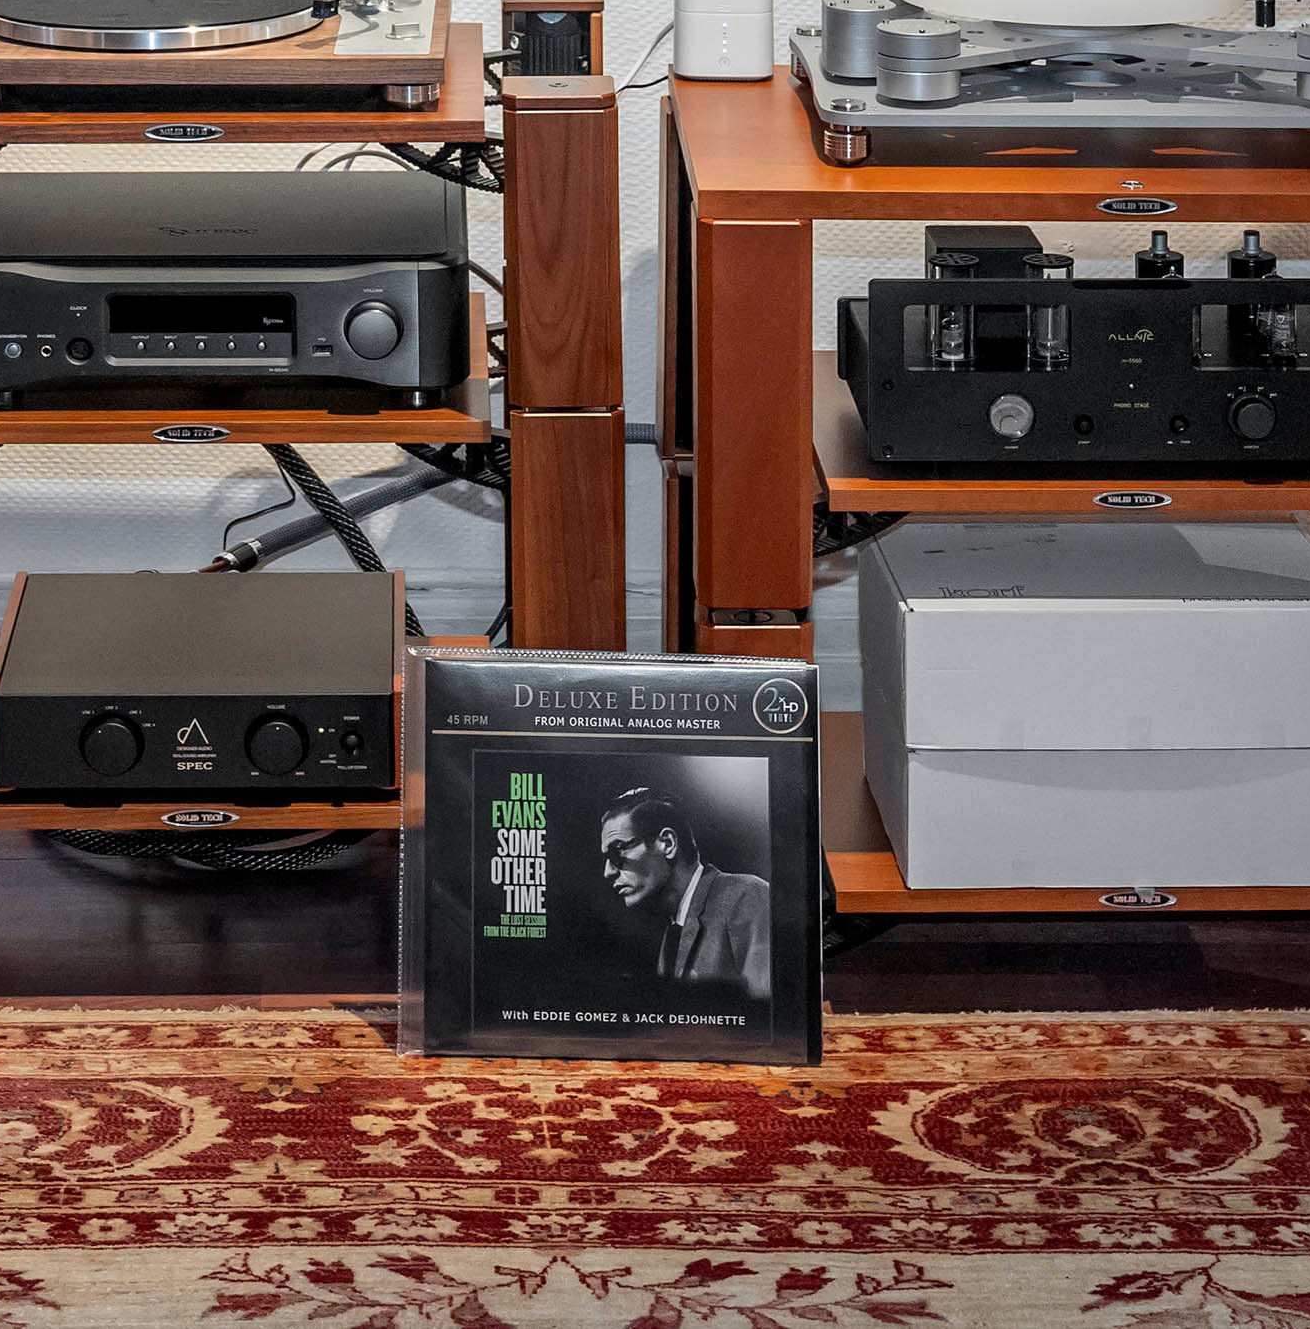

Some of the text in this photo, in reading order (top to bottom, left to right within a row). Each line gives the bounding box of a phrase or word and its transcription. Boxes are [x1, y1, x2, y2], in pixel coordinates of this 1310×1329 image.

[1112, 202, 1161, 210] SOLID TECH
[1108, 329, 1155, 343] ALLNIC
[1107, 495, 1156, 503] SOLID TECH
[446, 715, 489, 726] 45 RPM
[534, 716, 721, 730] FROM ORIGINAL ANALOG MASTER
[177, 761, 213, 771] SPEC
[510, 772, 547, 801] BILL
[175, 813, 224, 822] SOLID TECH
[491, 800, 547, 829] EVANS
[496, 828, 547, 857] SOME
[490, 856, 547, 885] OTHER
[503, 885, 547, 913] TIME
[502, 1010, 746, 1026] With EDDIE GOMEZ & JACK DEJOHNETTE
